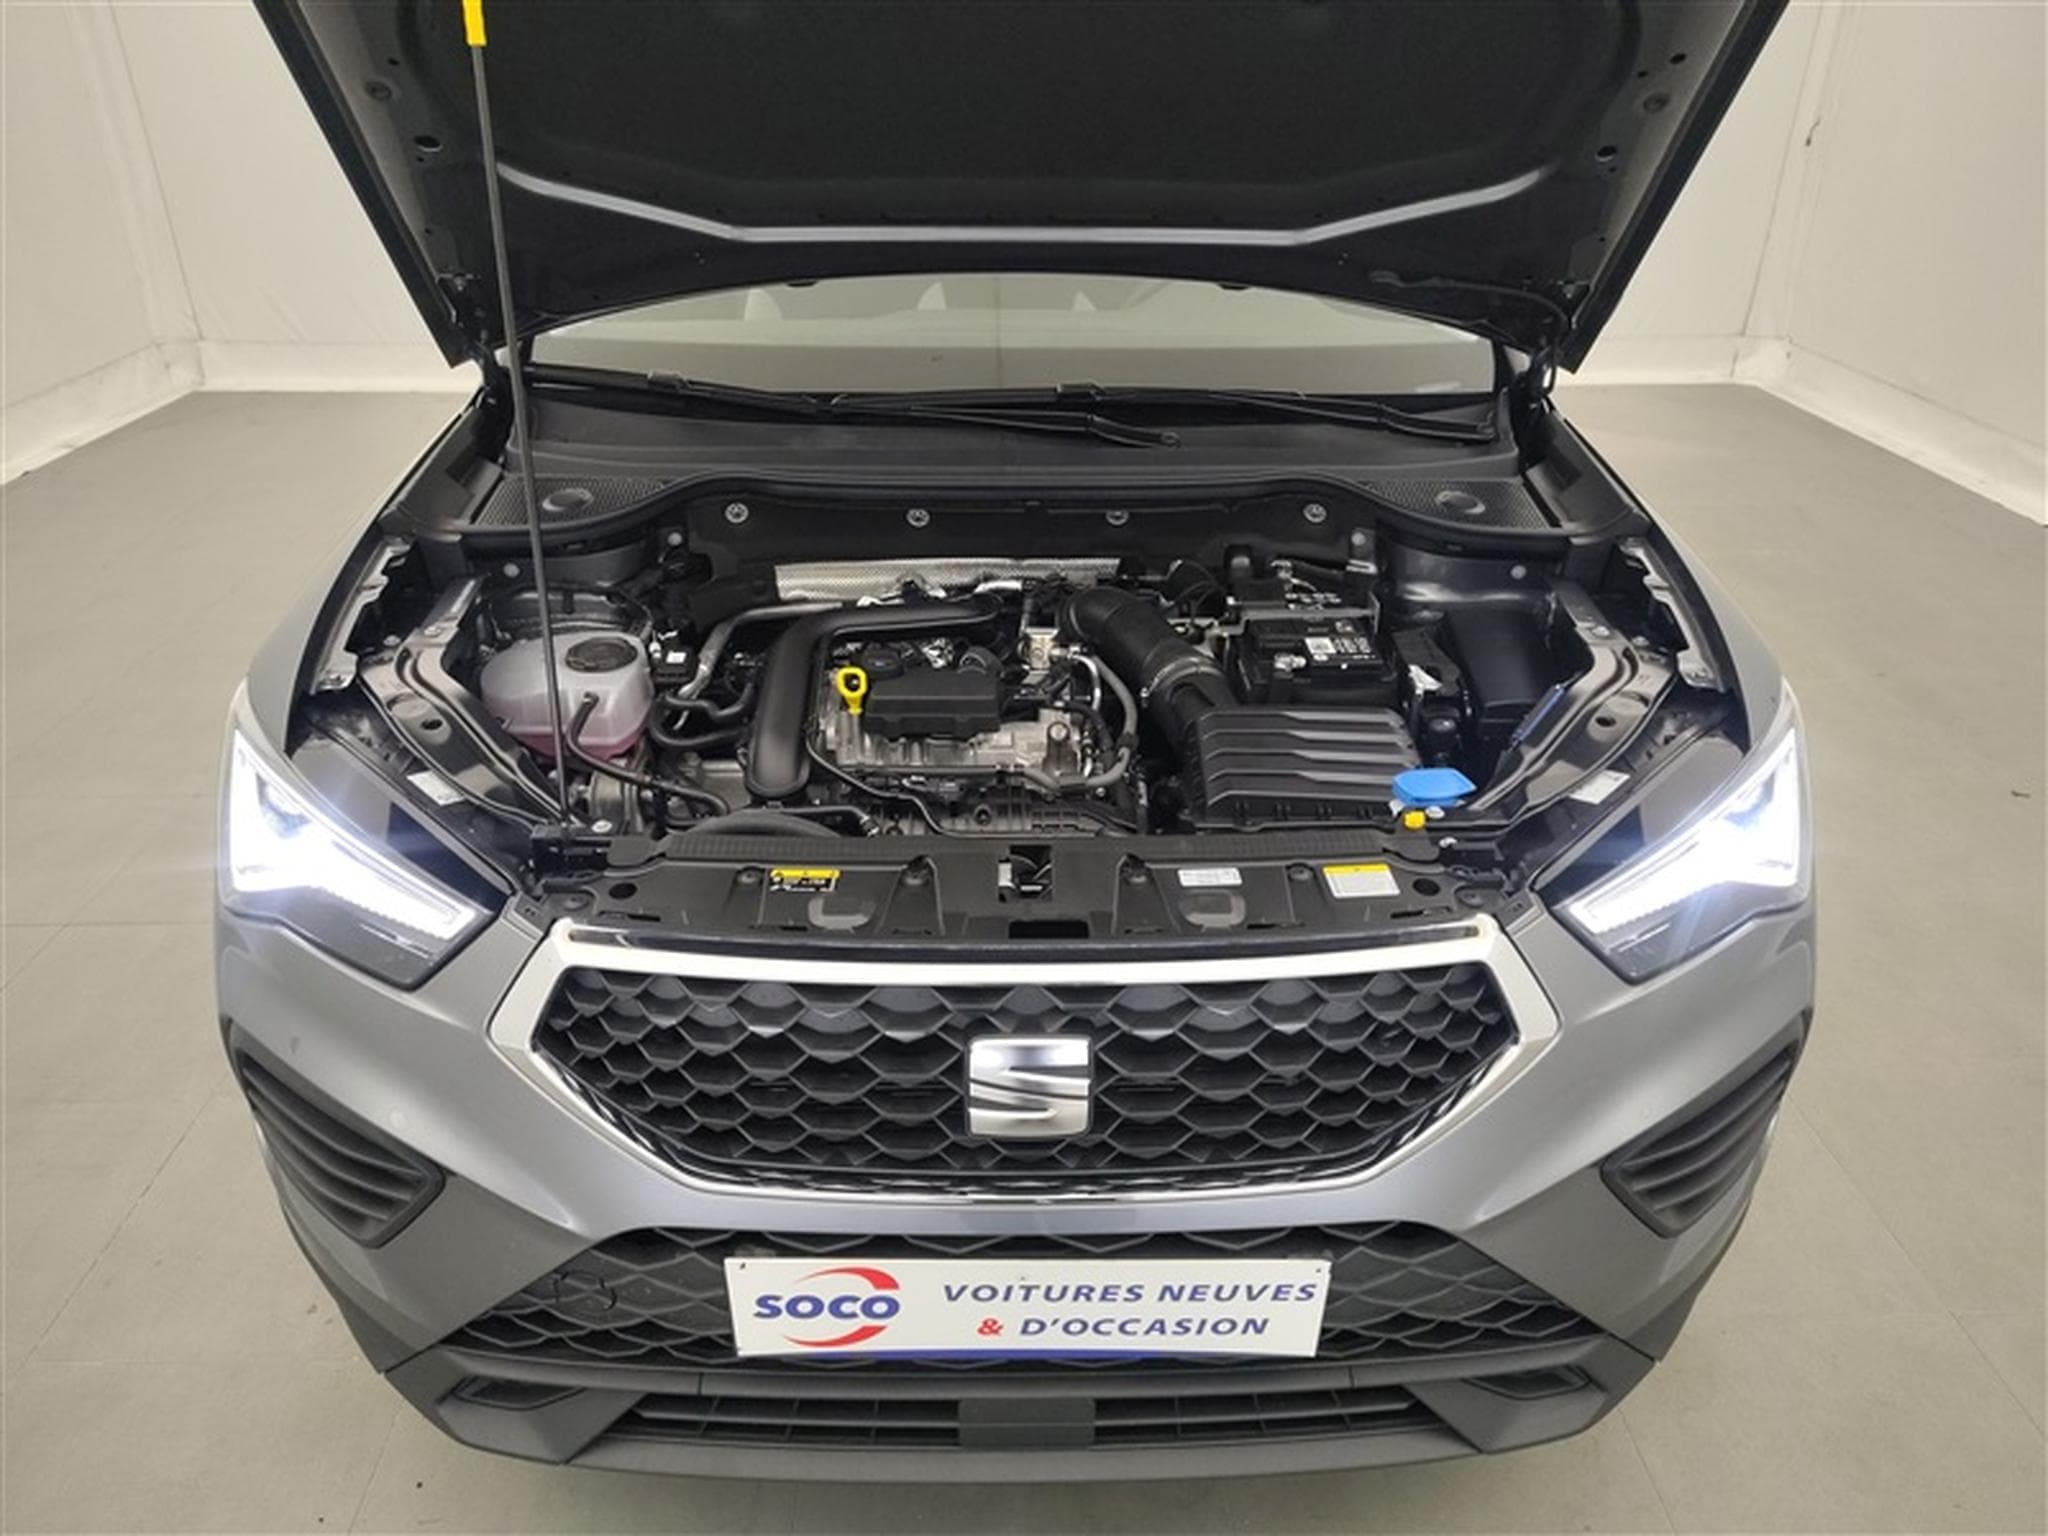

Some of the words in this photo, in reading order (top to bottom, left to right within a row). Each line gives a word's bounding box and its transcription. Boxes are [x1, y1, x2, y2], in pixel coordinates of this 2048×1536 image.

[943, 1283, 1145, 1303] VOITURES
[1157, 1283, 1318, 1303] NEUVES
[752, 1293, 901, 1320] SOCO
[976, 1317, 1004, 1337] &
[1020, 1317, 1270, 1337] D'OCCASION
